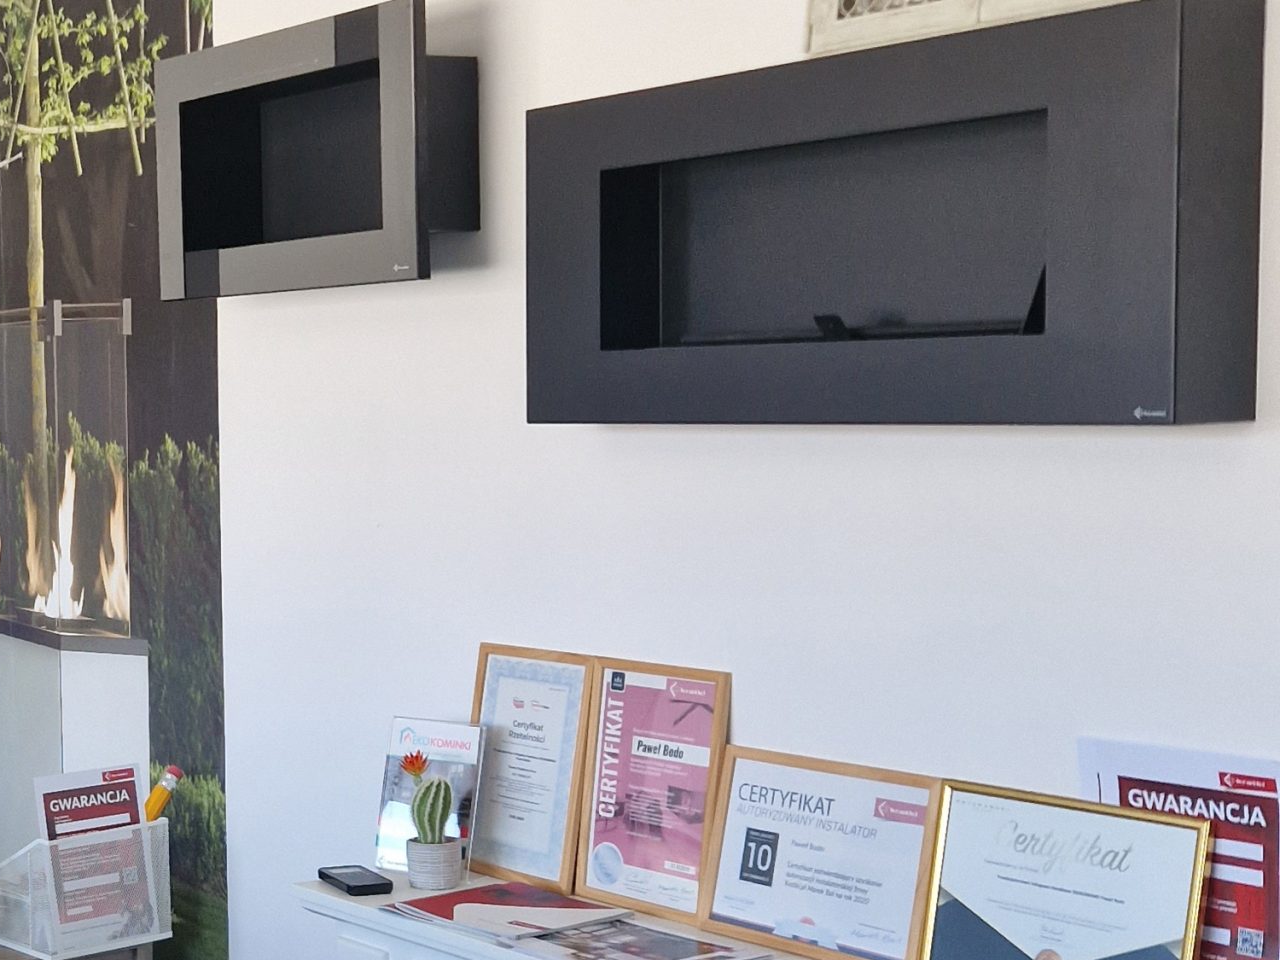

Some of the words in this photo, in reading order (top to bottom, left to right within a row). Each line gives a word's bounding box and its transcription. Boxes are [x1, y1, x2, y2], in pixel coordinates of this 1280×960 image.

[512, 719, 544, 732] Certyfikat
[598, 696, 625, 819] CERTYFIKAT
[49, 788, 131, 813] GWARANCJA
[738, 783, 836, 817] CERTYFIKAT
[1127, 787, 1267, 828] GWARANCJA
[735, 802, 815, 827] AUTORYZOWANY
[815, 817, 878, 840] INSTALATOR
[747, 842, 772, 871] 10
